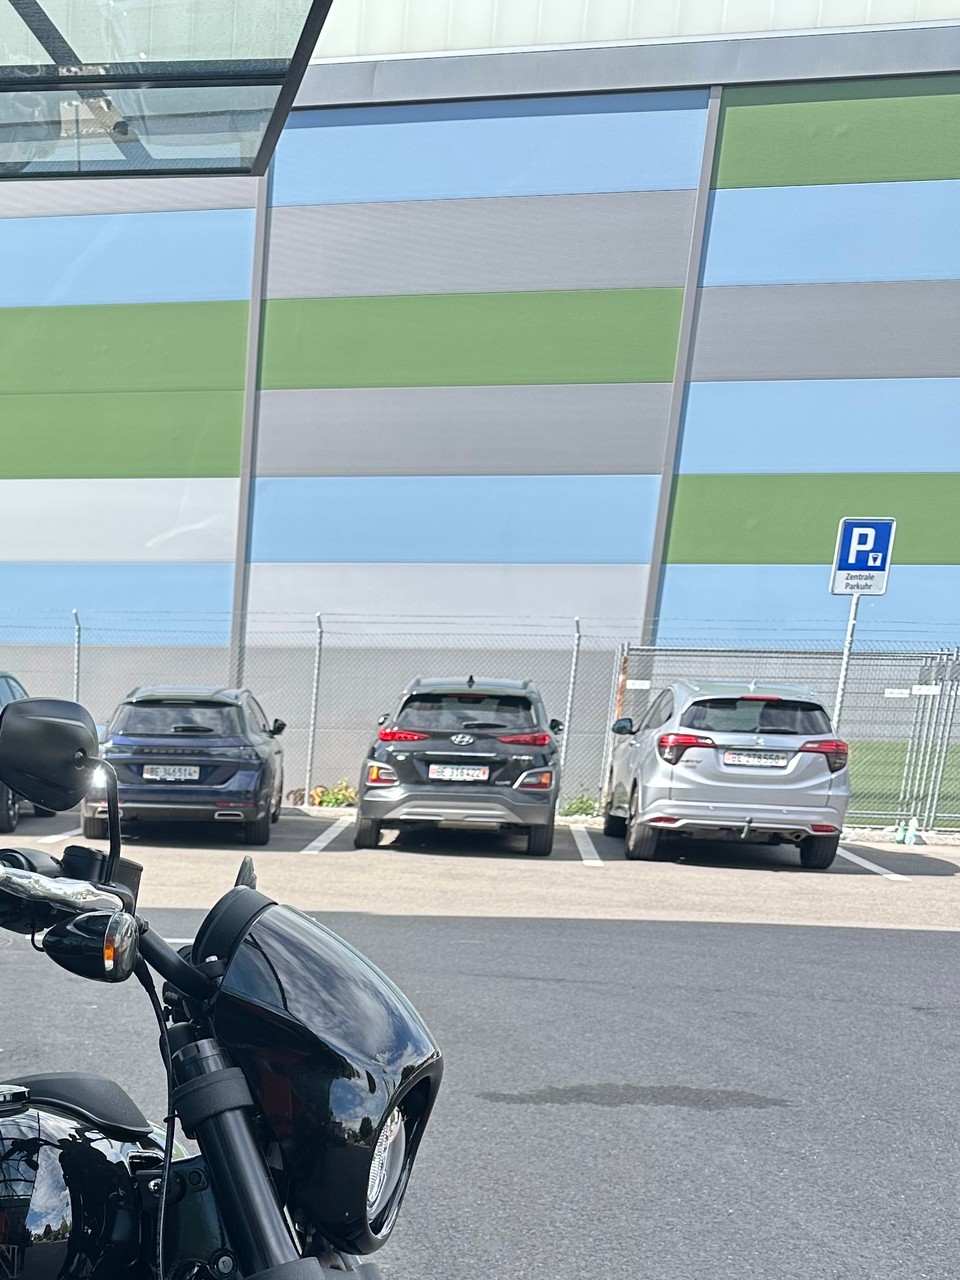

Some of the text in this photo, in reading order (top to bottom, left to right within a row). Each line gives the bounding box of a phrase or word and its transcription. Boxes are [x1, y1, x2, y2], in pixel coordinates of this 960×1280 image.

[848, 527, 876, 564] P
[845, 572, 875, 581] Zentrale
[844, 582, 873, 590] Parkuhr
